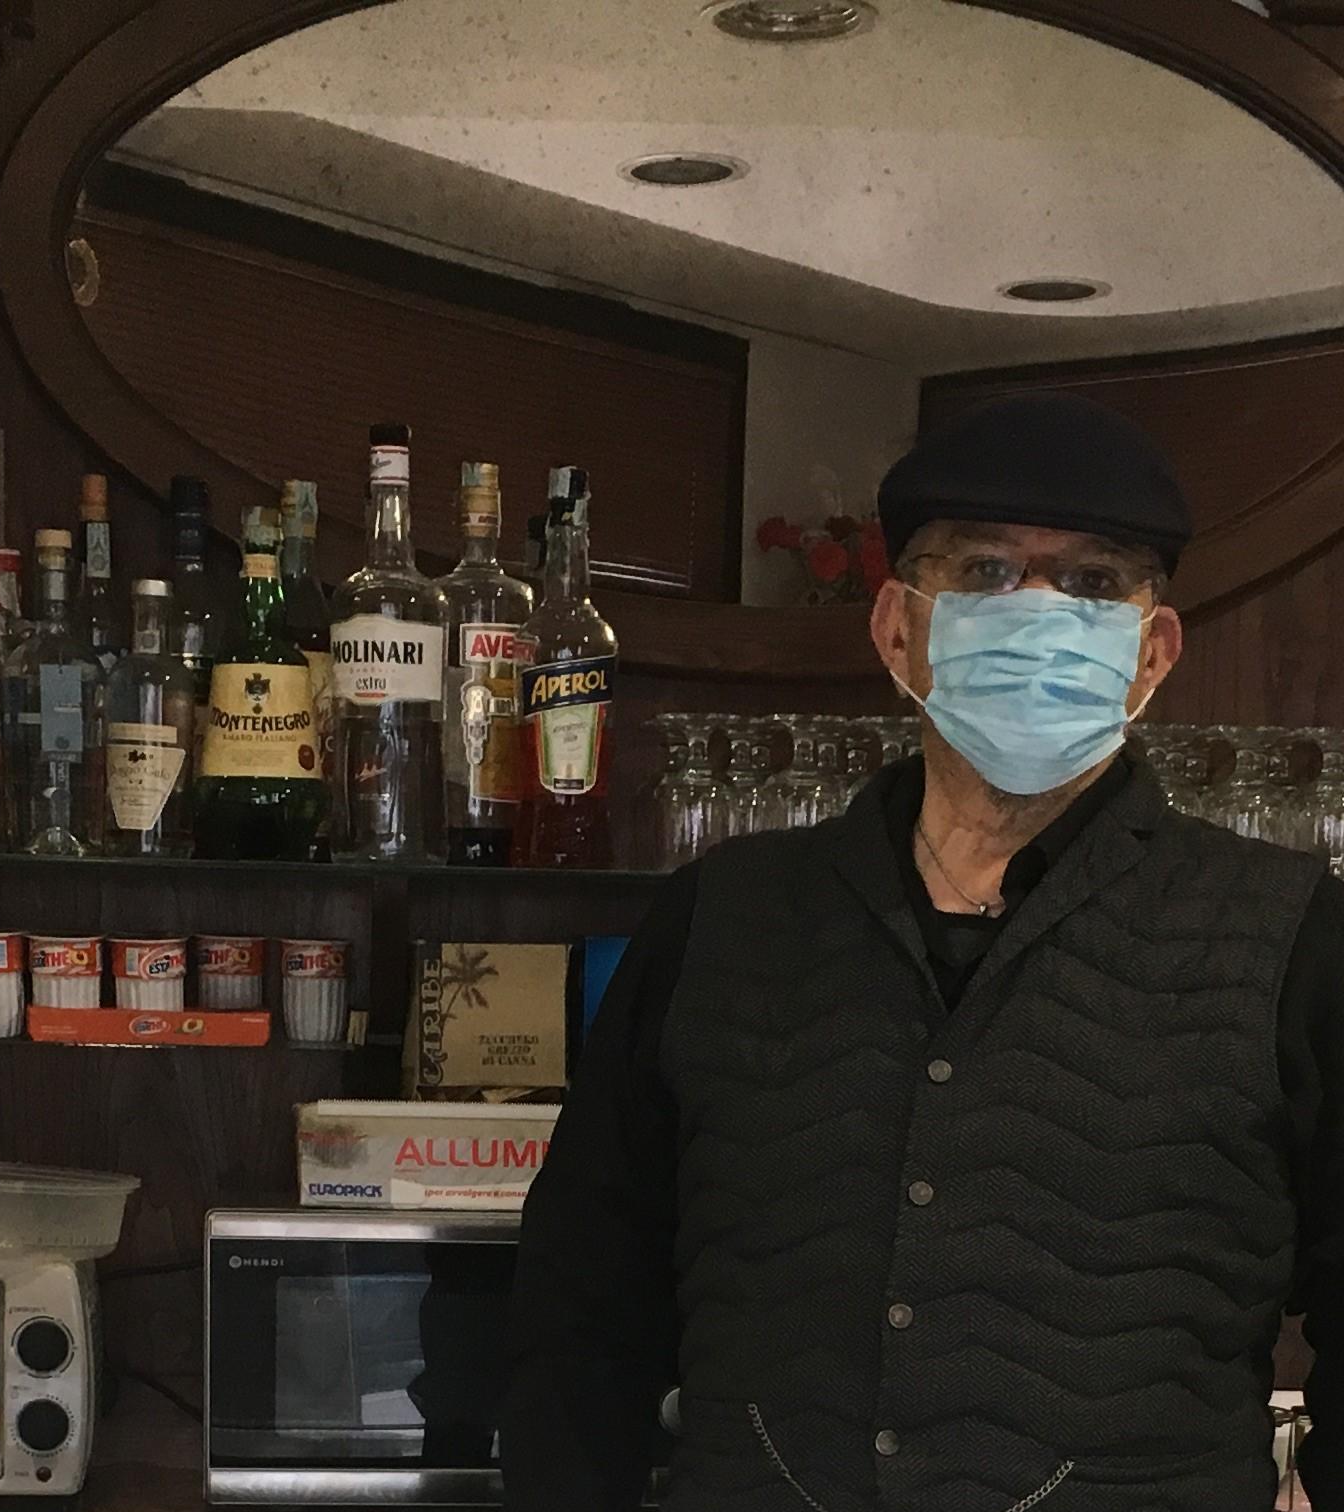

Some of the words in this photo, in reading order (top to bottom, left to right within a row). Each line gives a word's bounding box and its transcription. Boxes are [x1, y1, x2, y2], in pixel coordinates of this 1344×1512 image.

[530, 669, 608, 706] APEROL
[209, 706, 311, 734] MONTENEGRO
[420, 958, 448, 1086] CARIBE
[308, 1183, 383, 1198] EUROPACK
